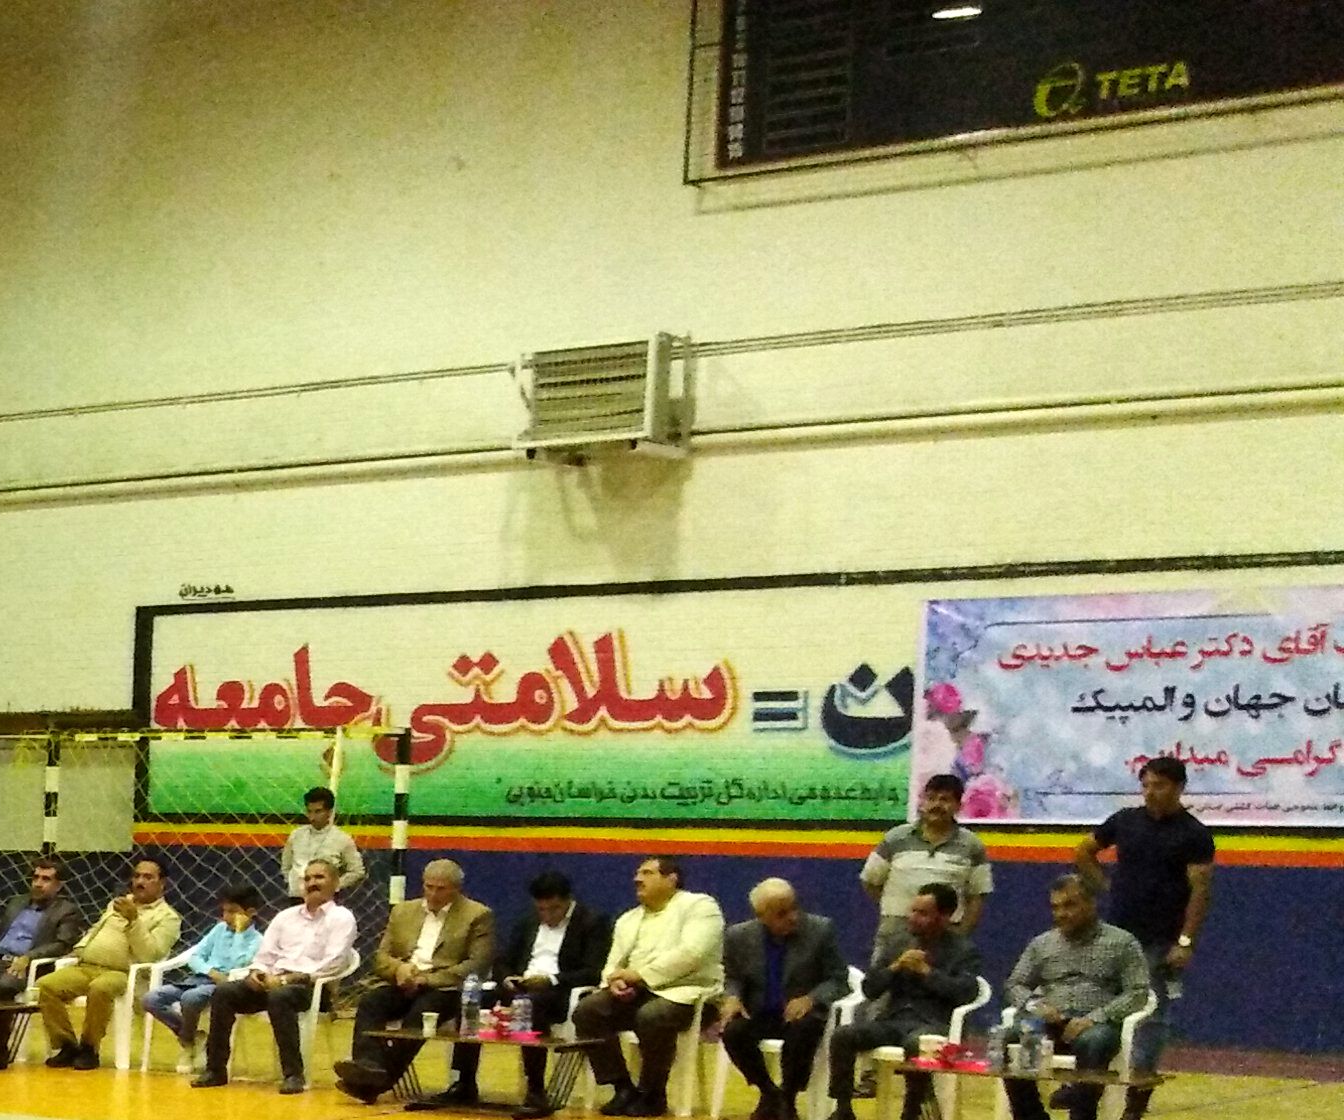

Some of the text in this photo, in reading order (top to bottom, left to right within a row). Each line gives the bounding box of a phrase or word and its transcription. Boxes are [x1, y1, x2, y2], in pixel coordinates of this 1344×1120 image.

[1096, 61, 1190, 99] TETA
[998, 643, 1100, 672] جدیدی
[1105, 634, 1188, 673] عباس
[1189, 632, 1254, 672] دکتر
[1261, 622, 1329, 665] آقای
[155, 643, 376, 768] جامعه
[373, 629, 730, 768] سلامتی
[1203, 683, 1297, 720] جهان
